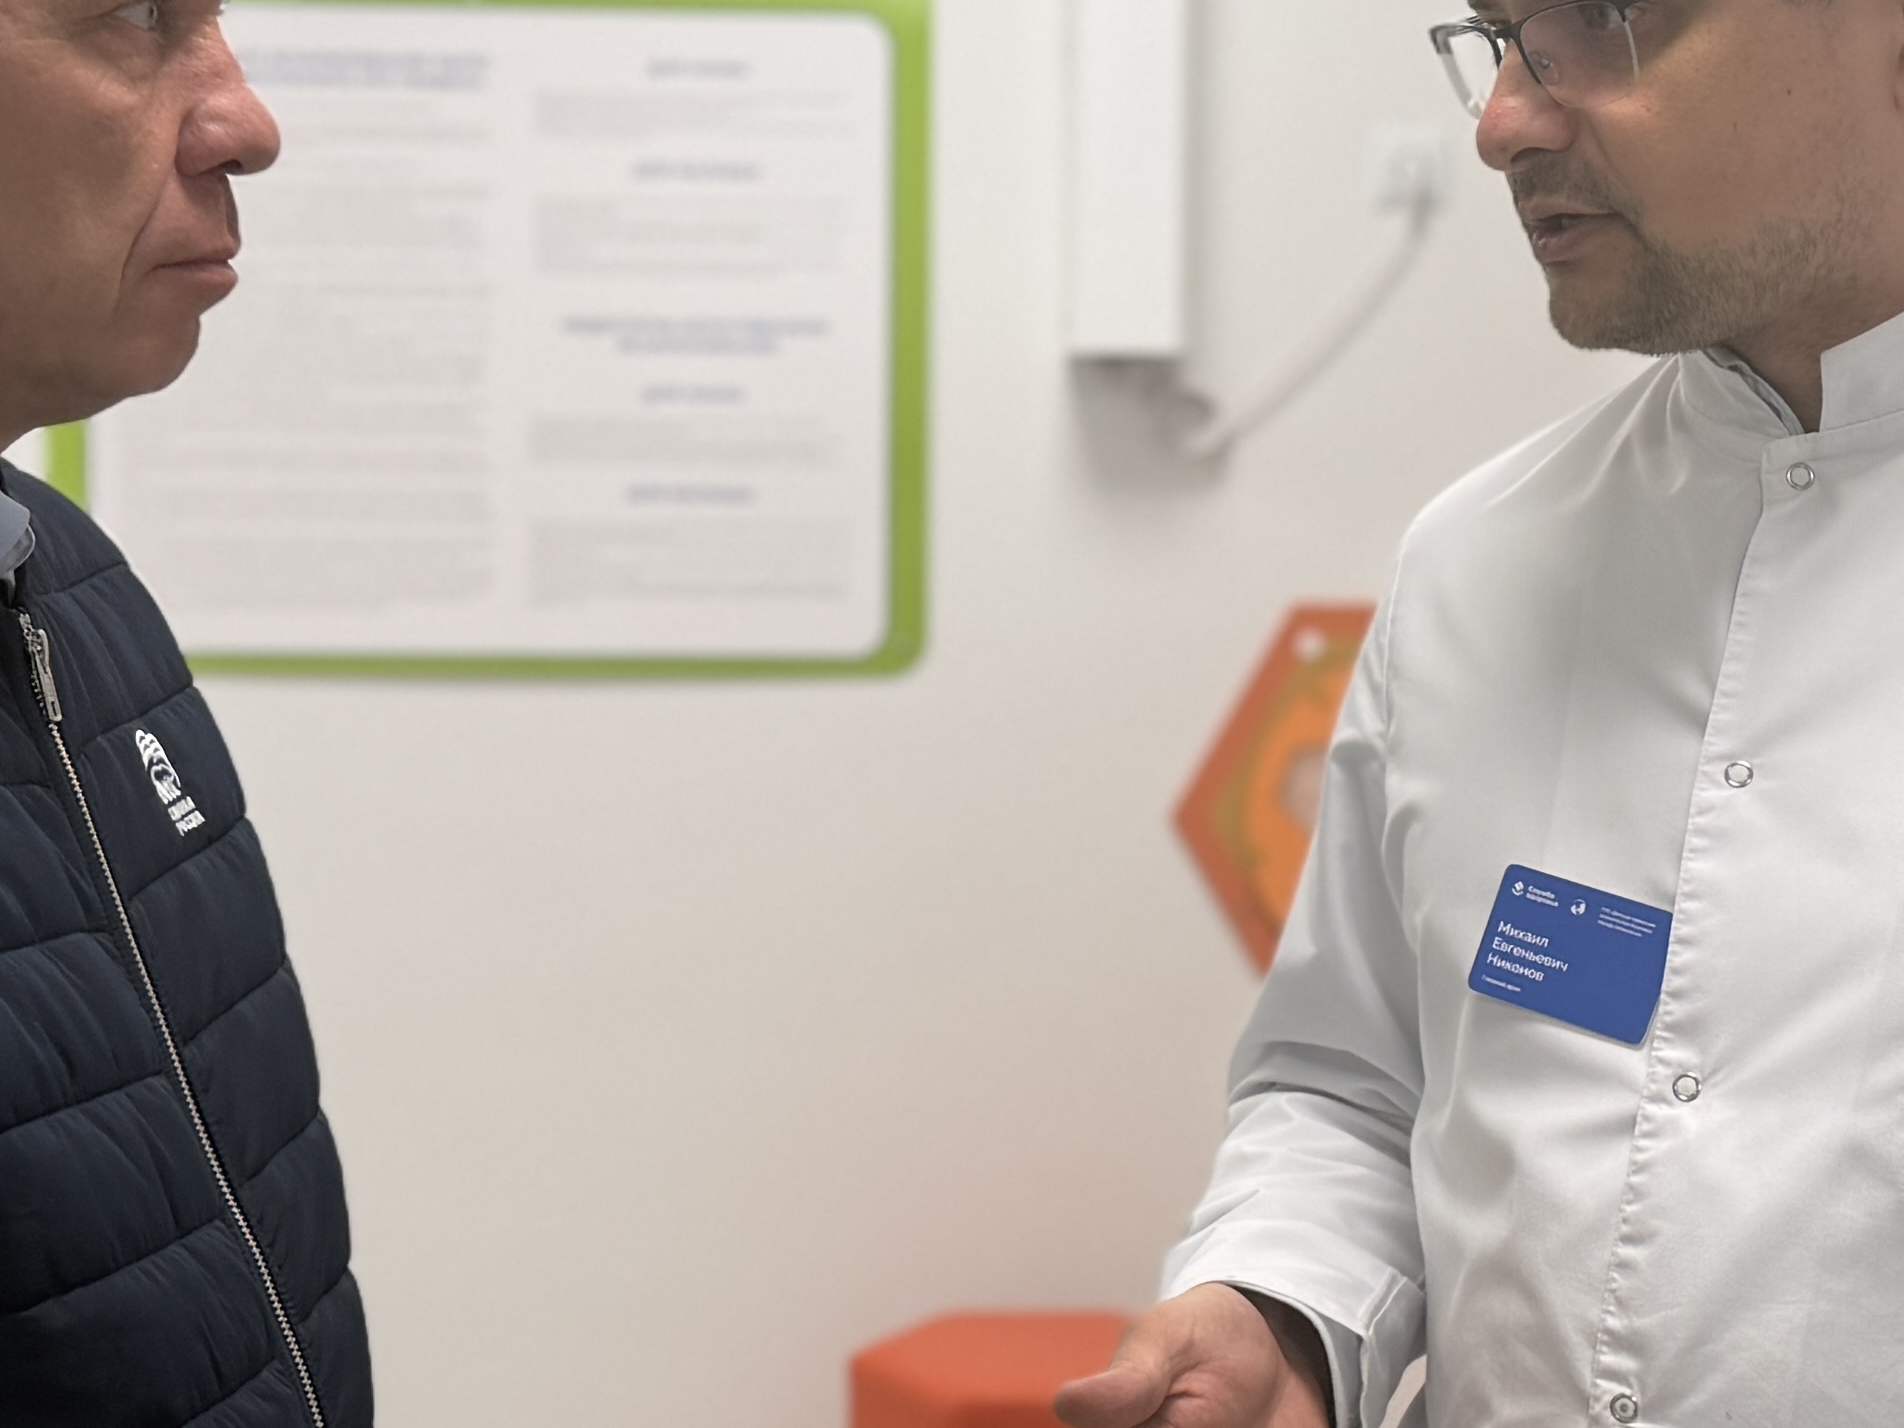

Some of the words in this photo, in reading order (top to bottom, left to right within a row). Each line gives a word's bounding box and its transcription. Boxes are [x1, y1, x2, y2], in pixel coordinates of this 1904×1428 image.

[1498, 921, 1549, 947] Михаил
[1486, 953, 1544, 981] Никонов
[1492, 937, 1568, 972] Евгеньевич
